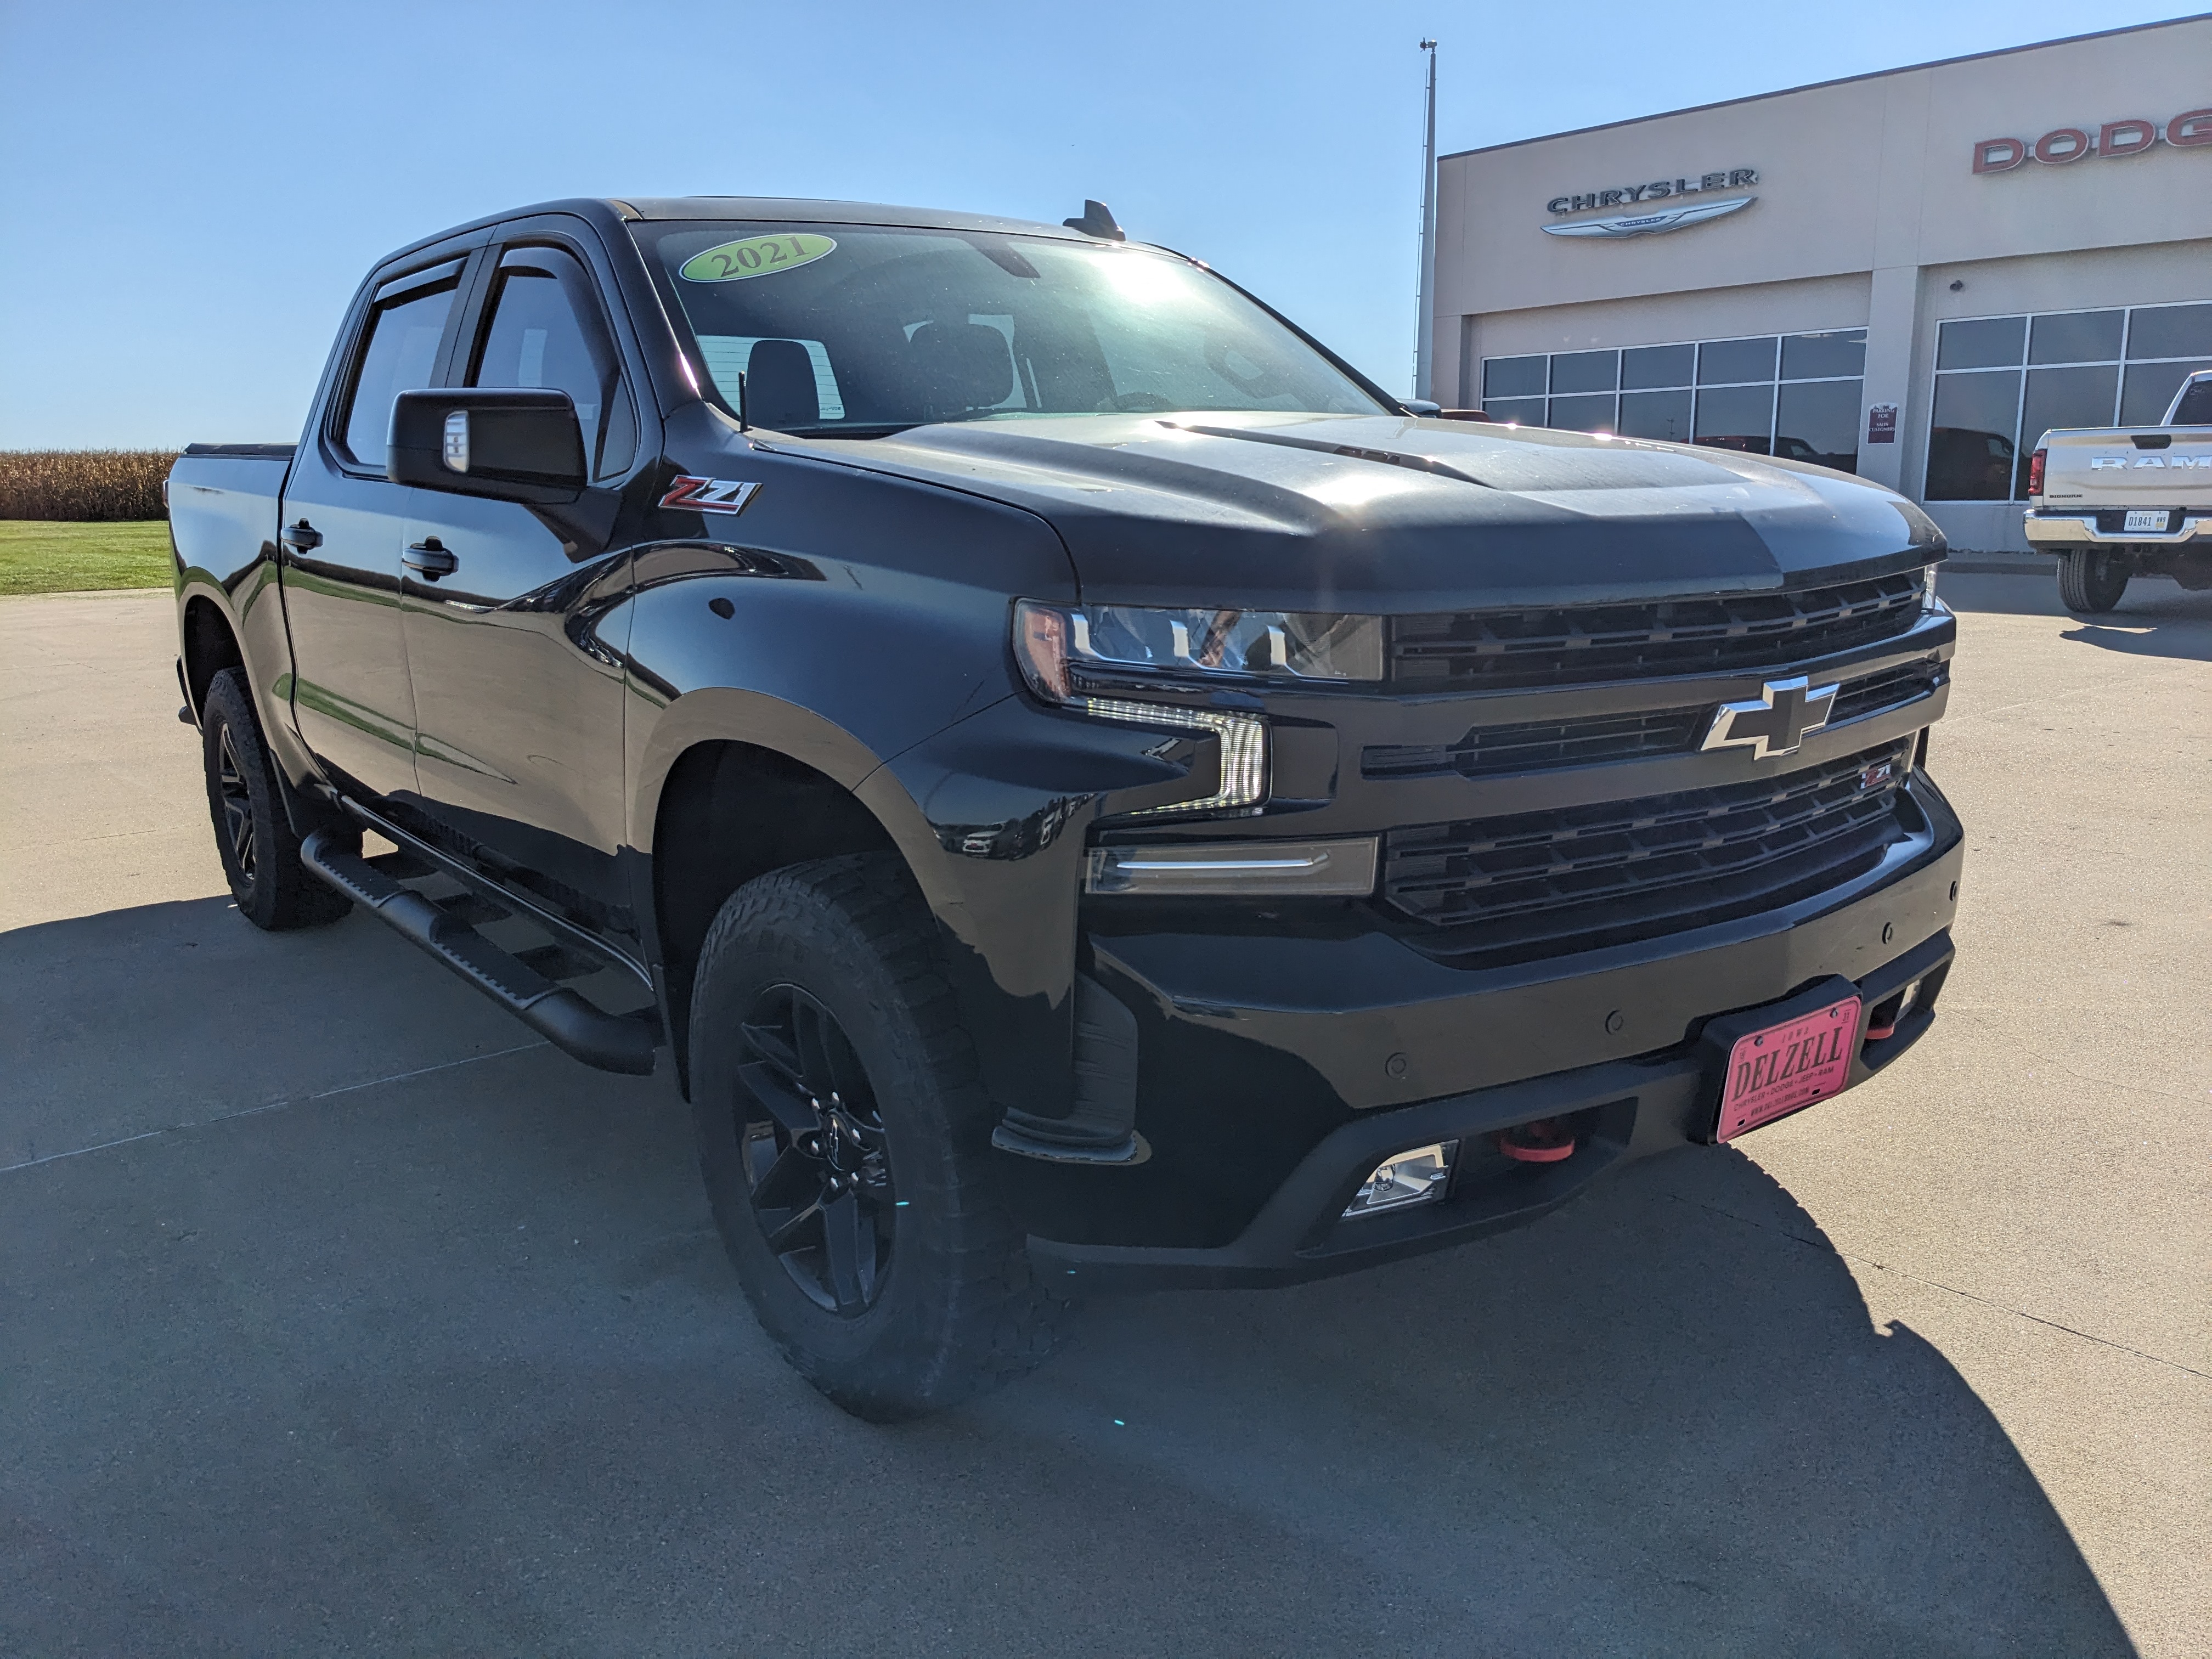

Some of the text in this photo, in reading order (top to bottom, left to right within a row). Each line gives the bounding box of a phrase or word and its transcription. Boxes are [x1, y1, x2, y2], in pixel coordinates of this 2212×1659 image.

[1547, 168, 1757, 213] CHRYSLER
[1620, 218, 1661, 226] CHRYSLER
[711, 236, 810, 278] 2021
[2091, 455, 2212, 470] RAM
[658, 475, 764, 516] Z71
[1860, 764, 1892, 789] Z71
[1731, 1026, 1843, 1102] DELZELL
[1734, 1091, 1765, 1111] CHRYSLER
[1770, 1080, 1793, 1095] DODGE
[1818, 1065, 1834, 1076] RAM
